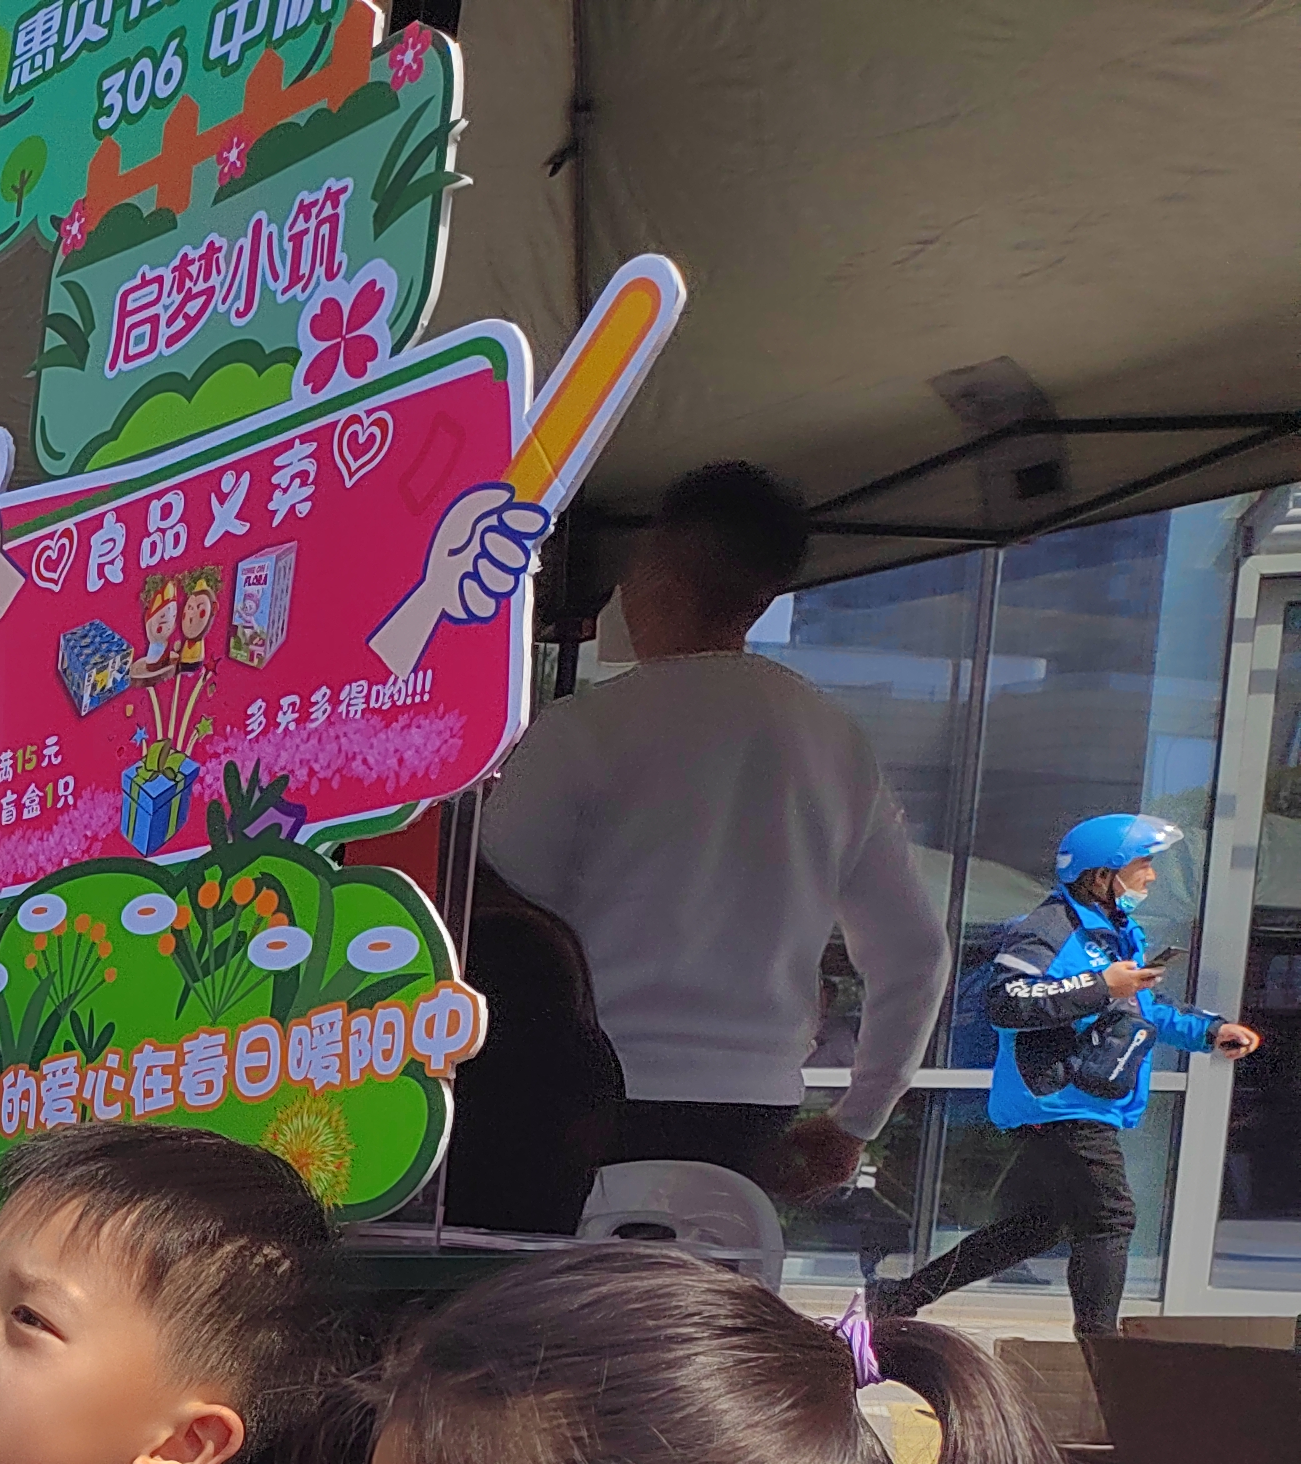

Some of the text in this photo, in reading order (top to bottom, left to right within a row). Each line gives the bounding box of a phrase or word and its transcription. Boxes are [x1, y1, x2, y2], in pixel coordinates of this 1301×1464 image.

[9, 0, 160, 92] 惠贞
[97, 41, 183, 131] 306
[108, 183, 348, 371] 启梦小筑
[87, 439, 317, 592] 良品义卖
